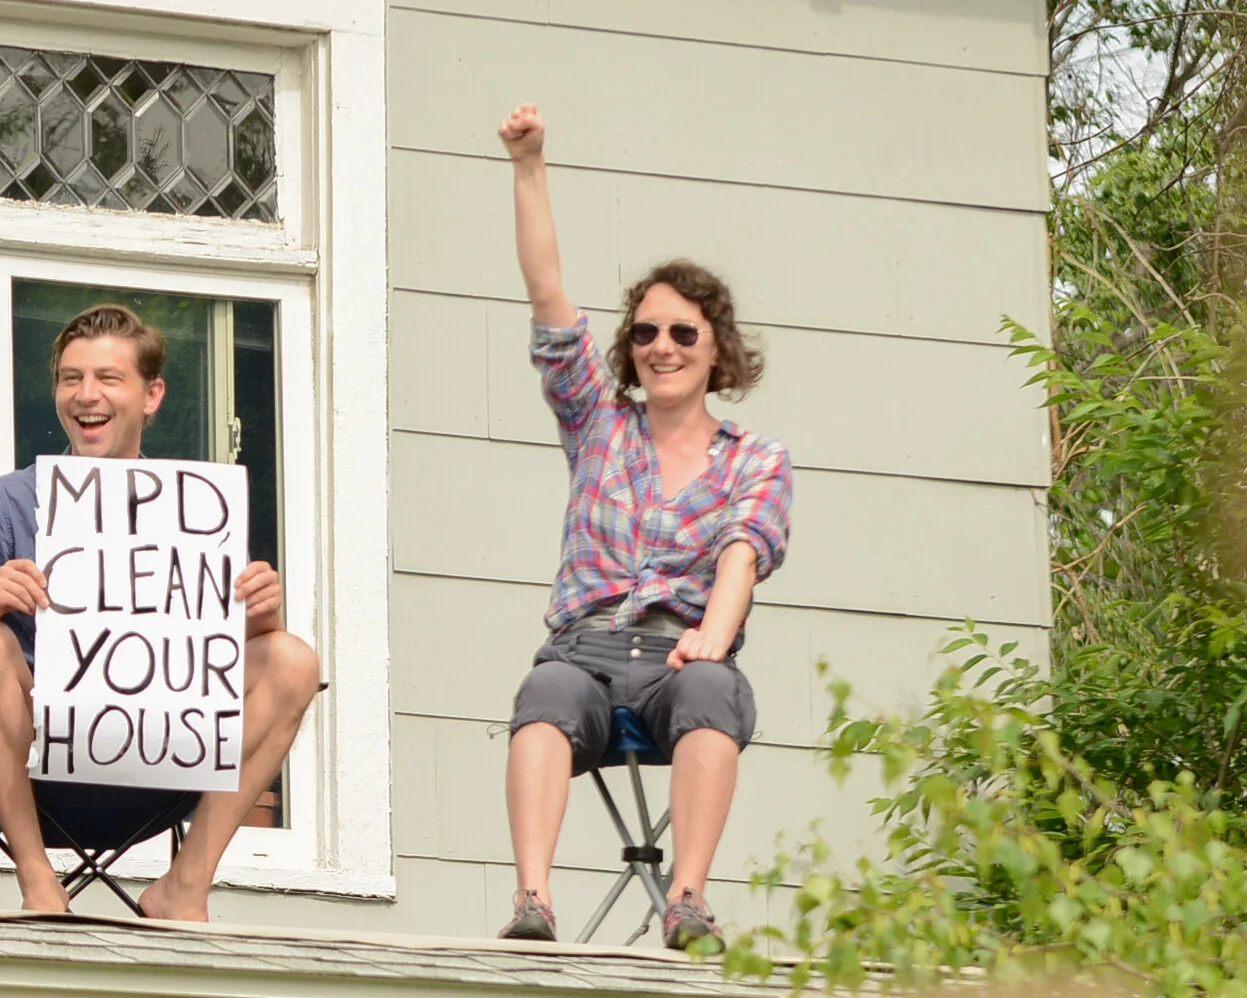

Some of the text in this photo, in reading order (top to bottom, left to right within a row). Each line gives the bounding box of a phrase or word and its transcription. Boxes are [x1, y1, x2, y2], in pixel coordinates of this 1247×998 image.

[46, 464, 231, 548] MPD,
[42, 544, 232, 620] CLEAN
[63, 627, 240, 700] YOUR
[41, 704, 241, 775] HOUSE
